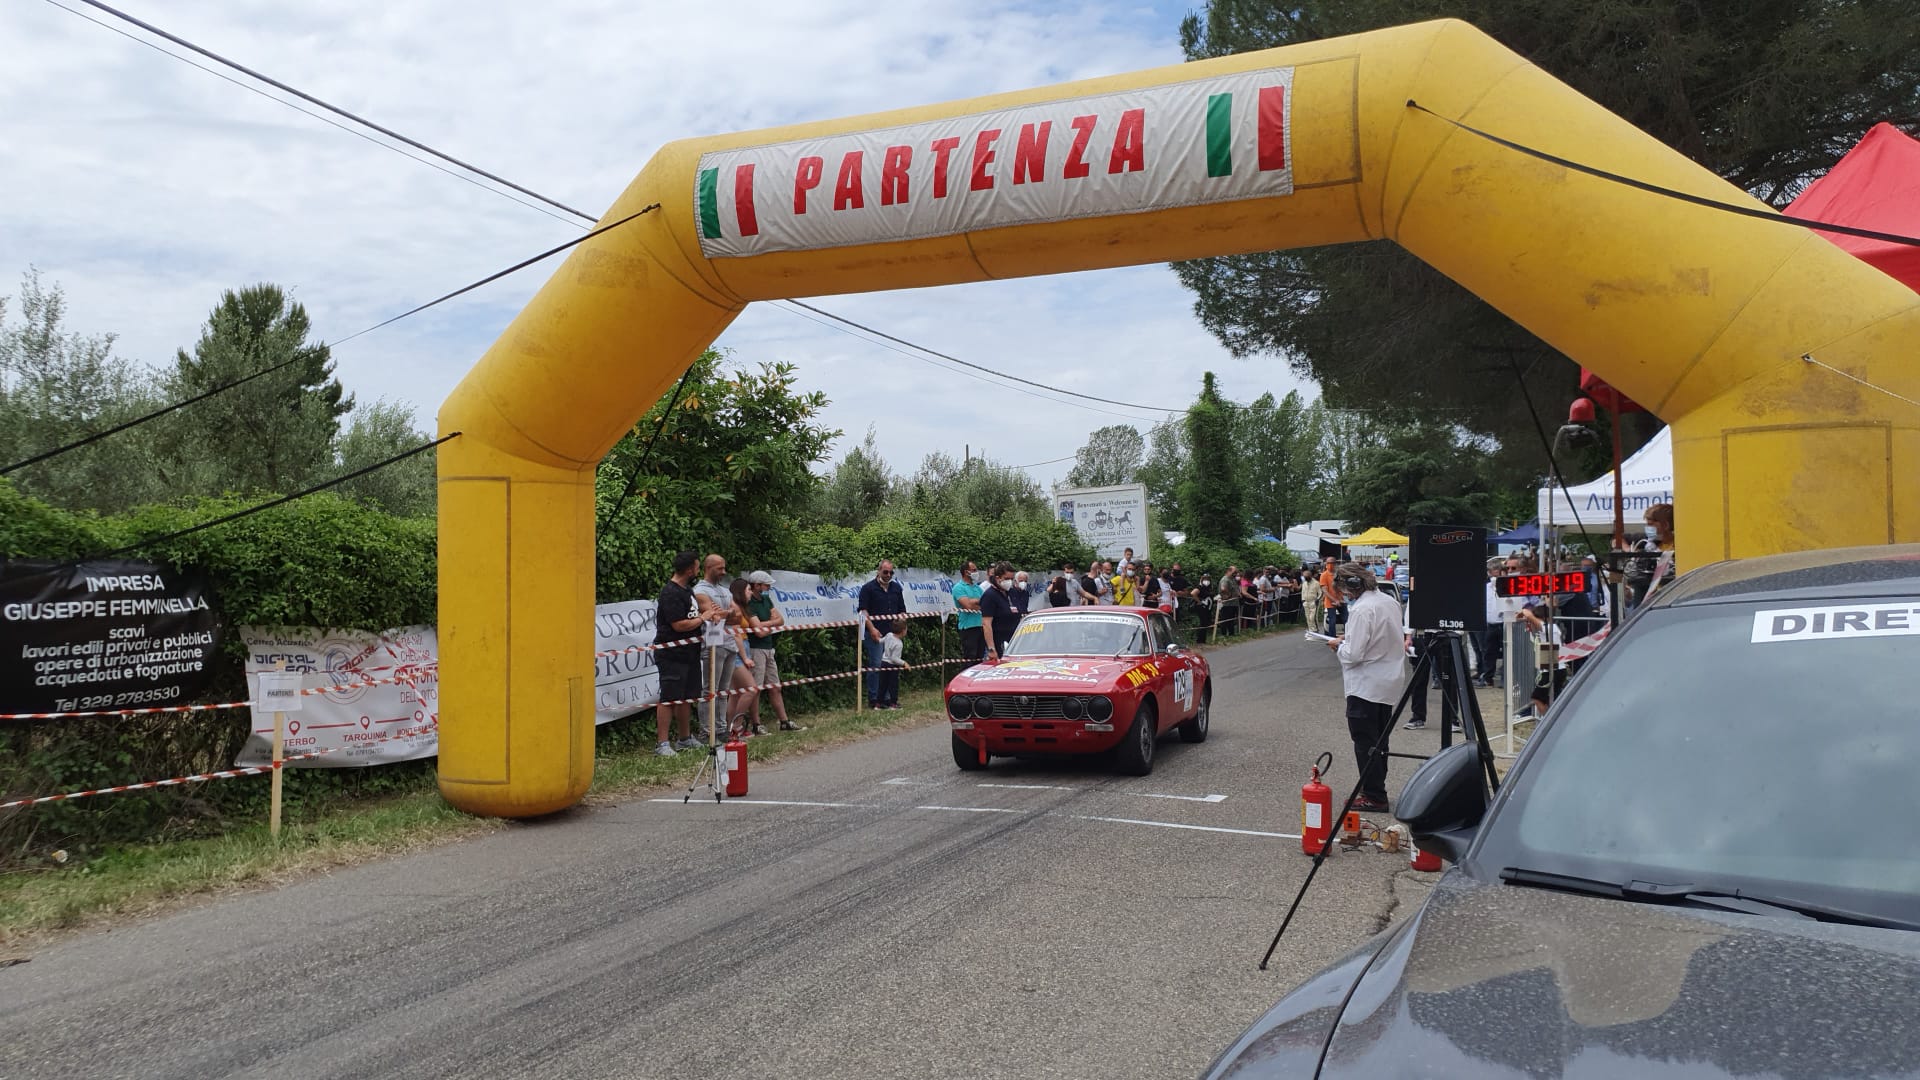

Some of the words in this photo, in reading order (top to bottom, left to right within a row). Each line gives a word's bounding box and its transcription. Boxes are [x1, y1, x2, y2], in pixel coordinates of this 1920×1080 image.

[794, 108, 1145, 215] PARTENZA
[1587, 490, 1673, 511] Auomob
[86, 574, 165, 592] IMPRESA
[4, 600, 106, 620] GIUSEPPE
[110, 595, 209, 617] FEMMINELLA
[109, 624, 145, 640] scavi
[596, 608, 657, 638] UROP
[1439, 619, 1464, 629] SL306
[1772, 608, 1920, 636] DIRE
[22, 642, 70, 659] lavori
[72, 640, 104, 655] edili
[106, 637, 152, 656] privati
[153, 640, 161, 649] e
[163, 631, 212, 651] pubblici
[34, 658, 83, 675] opere
[86, 655, 101, 668] di
[104, 646, 203, 667] urbanizzazione
[35, 669, 121, 688] acquedotti
[124, 668, 134, 679] e
[135, 661, 203, 681] fognature
[974, 674, 1040, 682] REGIONE
[1043, 674, 1098, 683] SICILIA
[55, 698, 77, 712] Tel
[79, 695, 114, 710] 328
[114, 686, 180, 706] 2783530
[283, 737, 317, 747] TERBO
[344, 731, 388, 743] TARQUINIA
